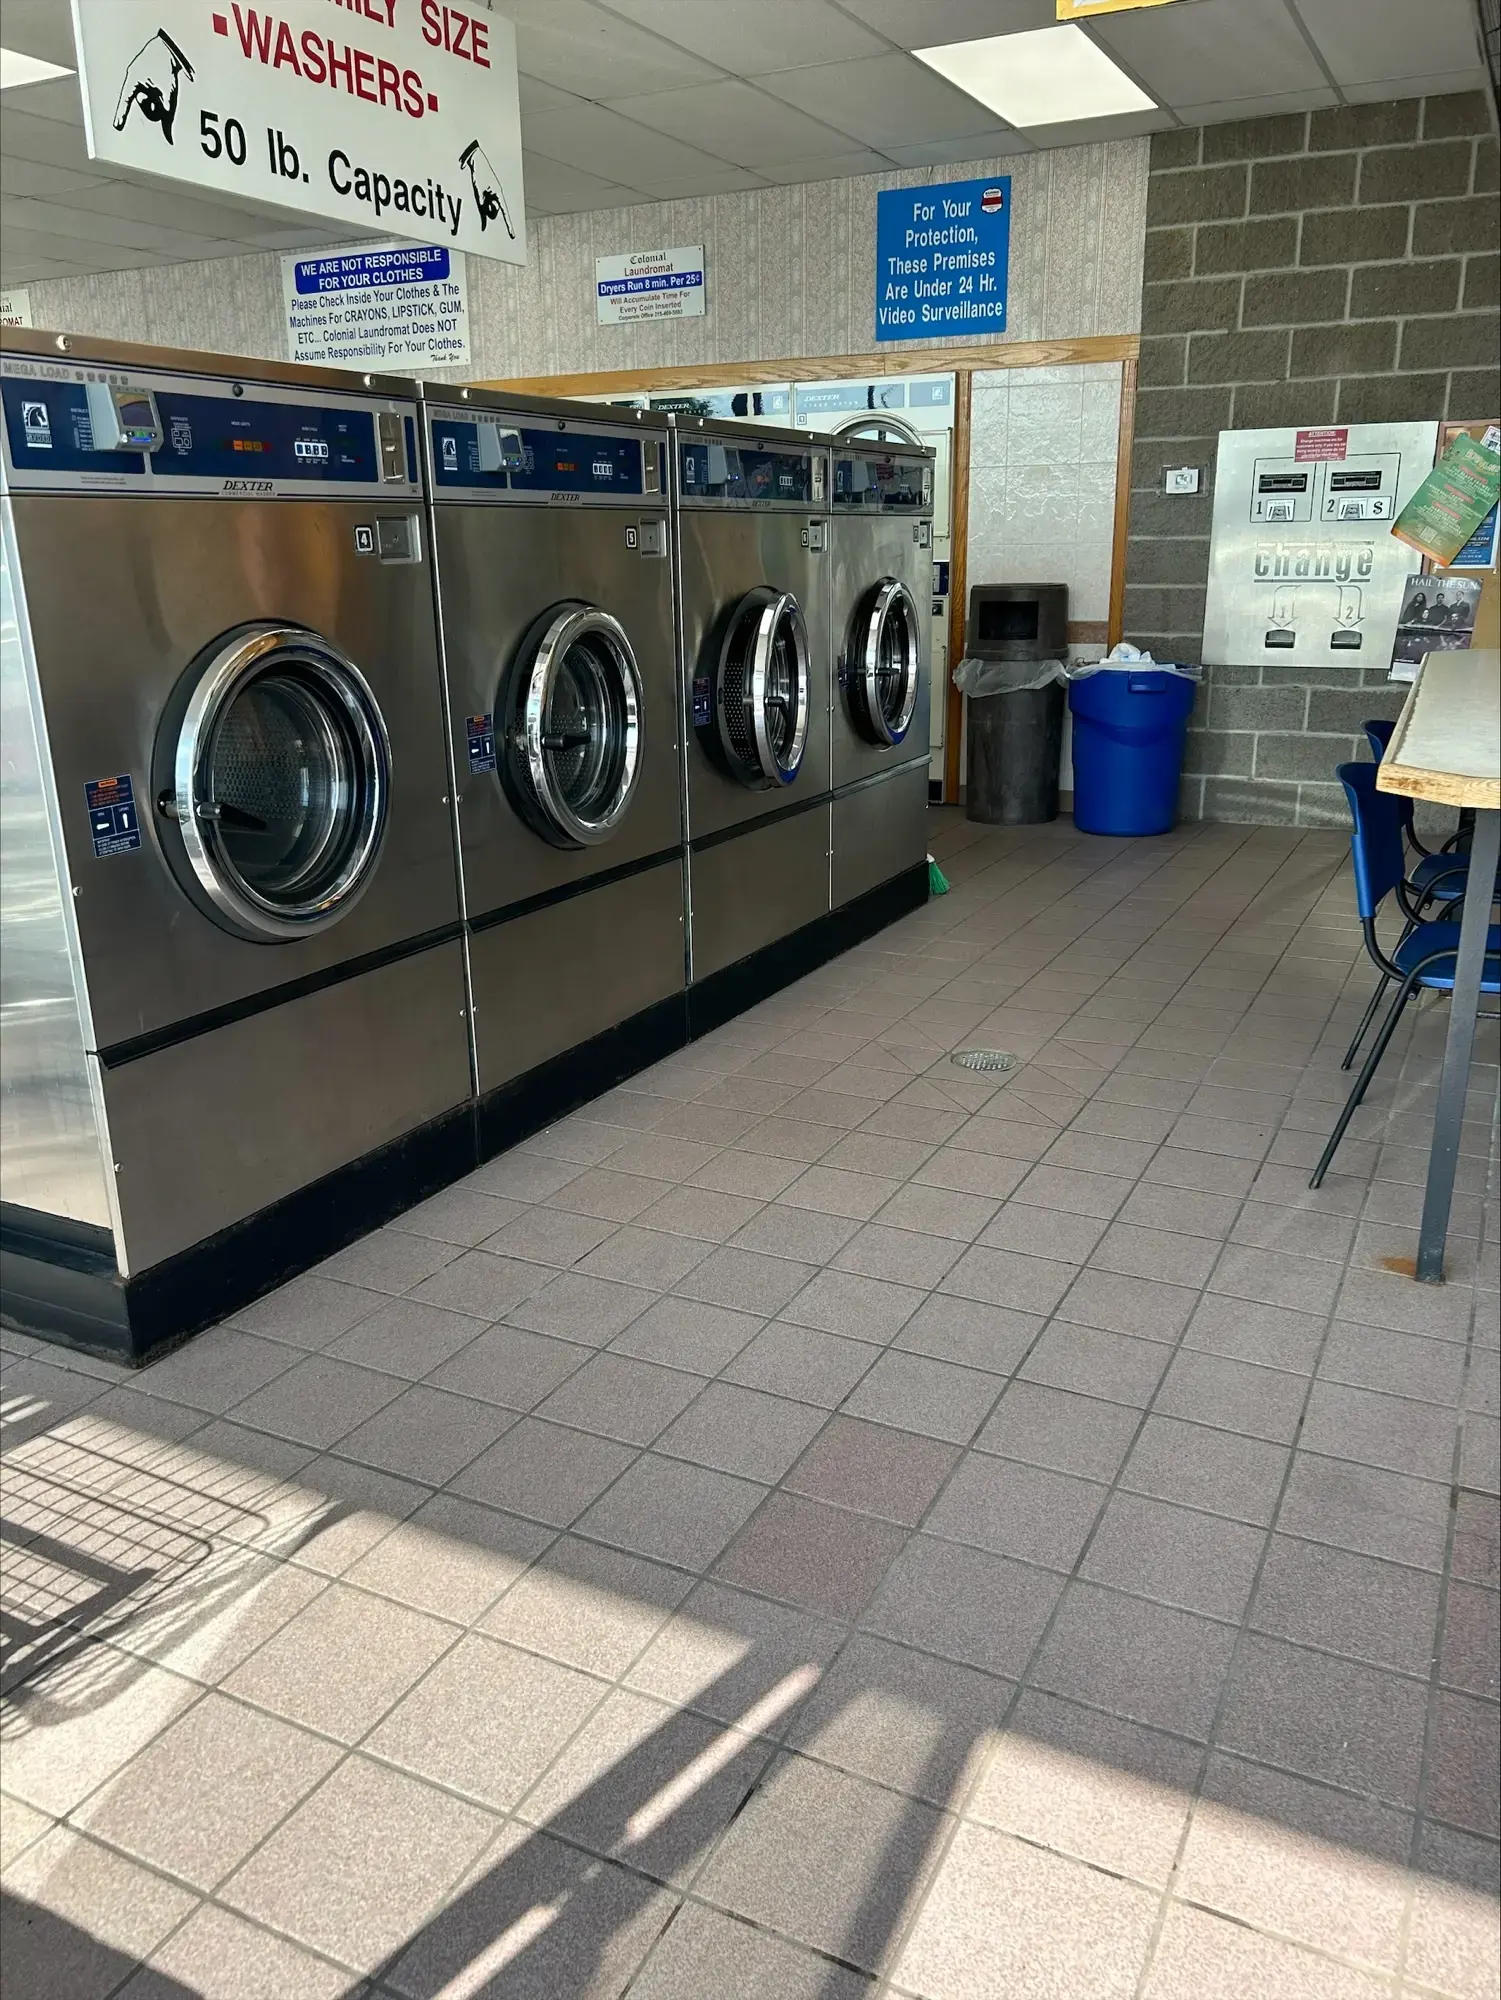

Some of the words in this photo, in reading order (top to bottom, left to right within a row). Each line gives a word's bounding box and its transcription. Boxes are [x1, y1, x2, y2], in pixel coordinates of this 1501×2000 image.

[421, 0, 491, 69] SIZE
[231, 2, 425, 118] WASHERS
[201, 110, 247, 166] 50
[267, 127, 309, 184] lb.
[328, 149, 462, 236] Capacity
[913, 203, 936, 222] For
[942, 199, 972, 219] Your
[905, 225, 979, 249] Protection,
[301, 264, 317, 276] WE
[319, 261, 340, 275] ARE
[341, 257, 363, 272] NOT
[364, 249, 442, 269] RESPONSIBLE
[630, 252, 667, 265] Colonial
[888, 257, 928, 276] These
[933, 250, 996, 271] Premises
[319, 277, 340, 290] FOR
[340, 273, 371, 287] YOUR
[372, 267, 424, 284] CLOTHES
[624, 263, 674, 277] Laundromat
[600, 283, 626, 295] Dryers
[627, 281, 643, 291] Run
[645, 279, 650, 288] 8
[651, 278, 669, 288] min.
[670, 276, 684, 286] Per
[885, 282, 908, 300] Are
[914, 279, 953, 298] Under
[959, 275, 973, 294] 24
[979, 273, 997, 292] Hr.
[291, 298, 318, 311] Please
[319, 294, 345, 307] Check
[346, 291, 372, 305] Inside
[373, 289, 394, 302] Your
[396, 285, 430, 299] Clothes
[433, 284, 440, 297] &
[442, 283, 460, 295] The
[623, 294, 661, 304] Accumulate
[662, 292, 678, 300] Time
[289, 314, 328, 329] Machines
[329, 312, 343, 325] For
[344, 307, 390, 322] CRAYONS,
[392, 303, 437, 319] LIPSTICK,
[439, 301, 465, 315] GUM,
[619, 306, 638, 314] Every
[639, 304, 654, 312] Coin
[655, 301, 682, 310] Inserted
[879, 307, 916, 325] Video
[921, 301, 1003, 322] Surveillance
[323, 328, 357, 342] Colonial
[358, 324, 410, 339] Laundromat
[412, 322, 436, 334] Does
[437, 318, 458, 331] NOT
[294, 350, 326, 362] Assume
[328, 343, 386, 358] Responsibility
[388, 342, 403, 353] For
[404, 340, 426, 352] Your
[428, 337, 466, 350] Clothes.
[430, 353, 447, 362] Thank
[449, 352, 460, 361] You
[3, 362, 37, 376] MEGA
[39, 364, 70, 379] LOAD
[658, 403, 690, 411] DEXTER
[803, 394, 840, 402] DEXTER
[223, 480, 273, 491] DEXTER
[550, 493, 581, 502] DEXTER
[1327, 499, 1335, 513] 2
[1256, 501, 1263, 515] 1
[360, 533, 368, 546] 4
[1254, 543, 1374, 582] change
[1411, 578, 1433, 587] HAIL
[1437, 579, 1457, 588] THE
[1457, 580, 1477, 590] SUN
[1346, 606, 1354, 620] 2
